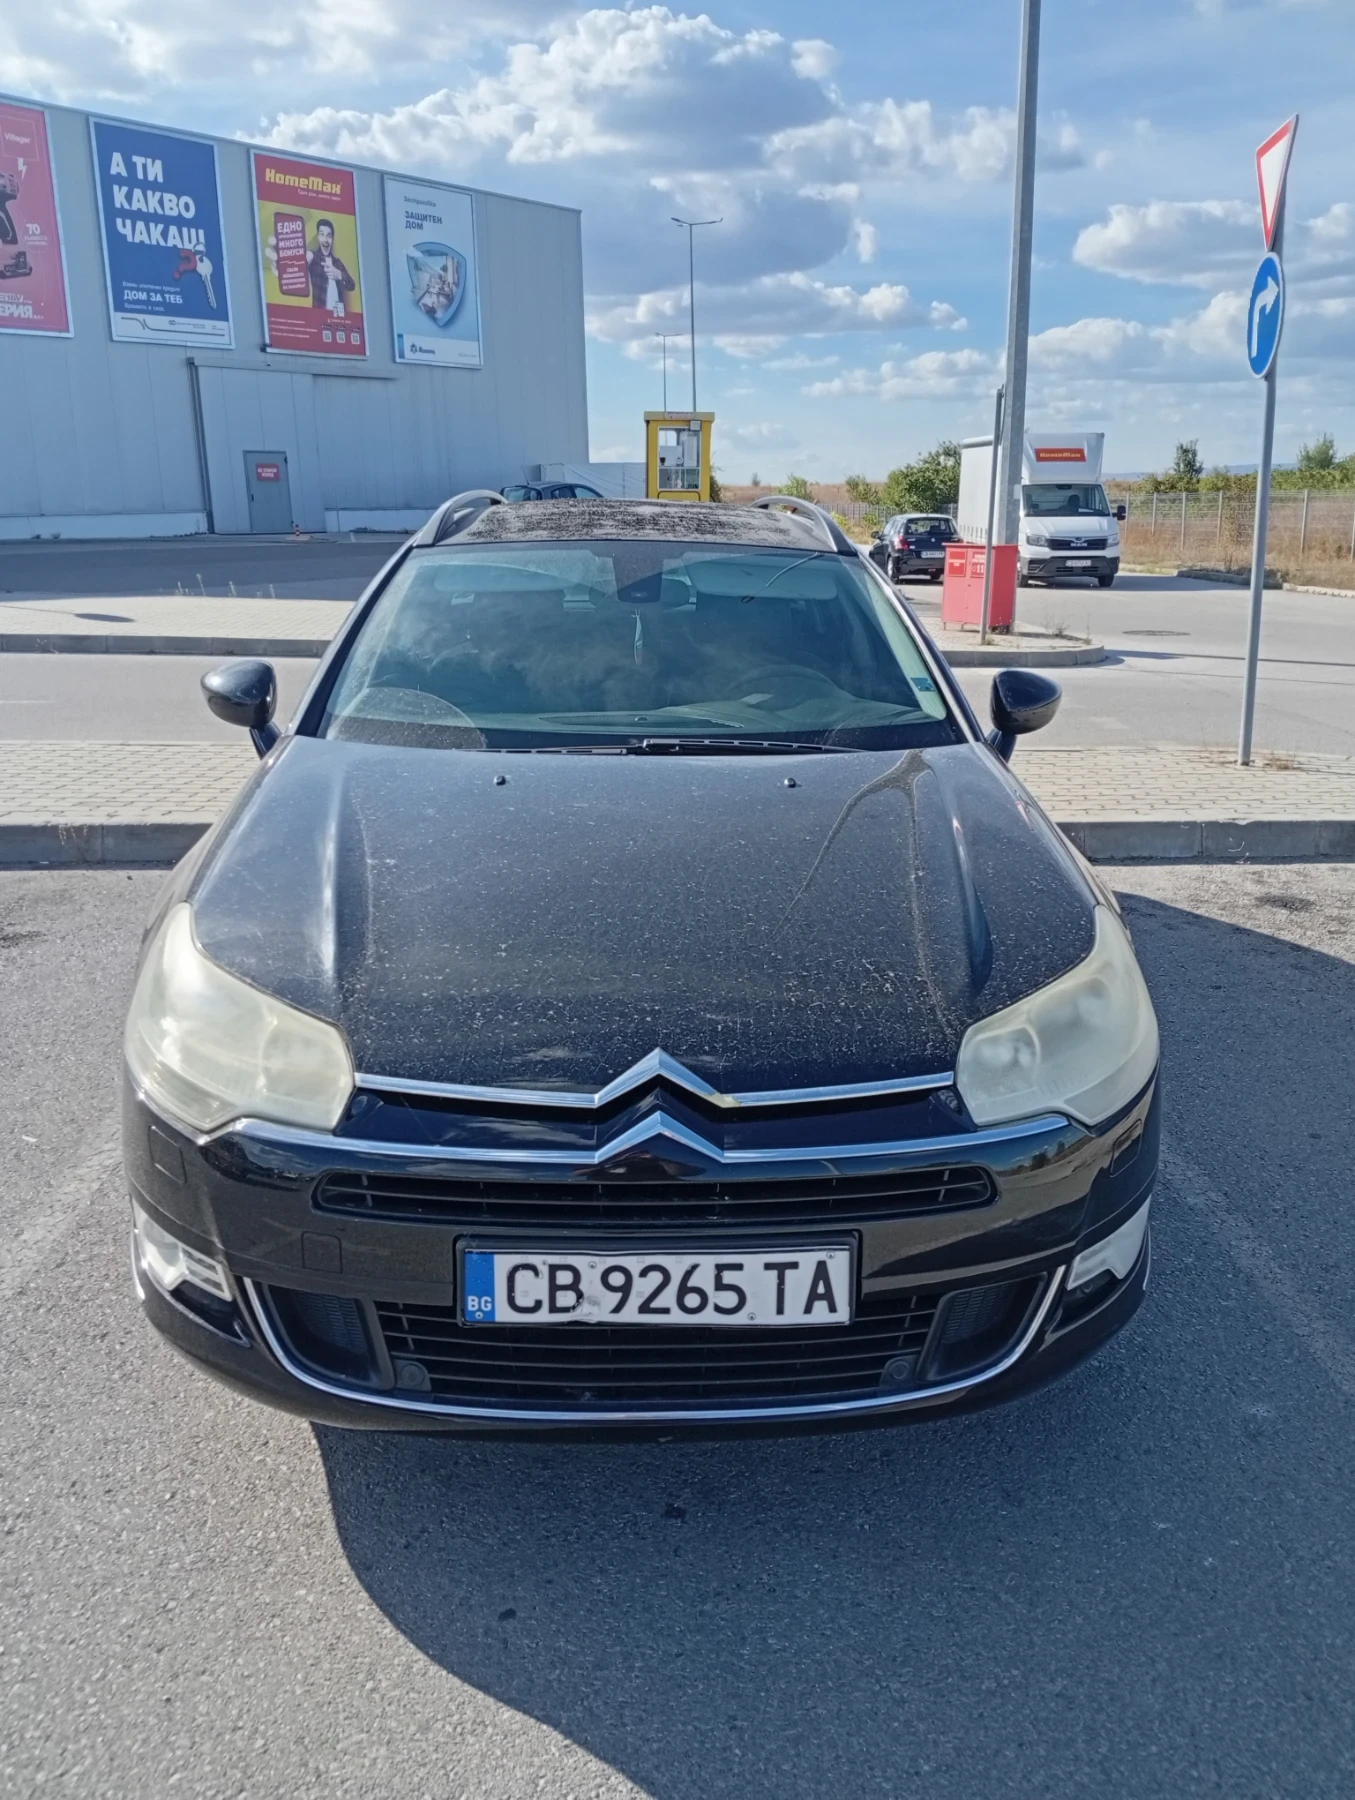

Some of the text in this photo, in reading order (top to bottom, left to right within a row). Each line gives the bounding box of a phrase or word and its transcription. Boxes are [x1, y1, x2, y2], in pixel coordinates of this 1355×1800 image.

[110, 152, 164, 183] А ТИ
[265, 168, 341, 194] HomeMax
[113, 184, 196, 219] КАКВО
[405, 210, 443, 225] ЗАЩИТЕН
[277, 221, 303, 234] ЕДНО
[405, 220, 424, 231] ДОМ
[278, 238, 304, 249] МНОГО
[280, 248, 305, 257] БОНУСИ
[123, 289, 183, 304] ДОМ ЗА ТЕБ
[506, 1260, 838, 1316] CB 9265 TA
[467, 1296, 493, 1312] BG
